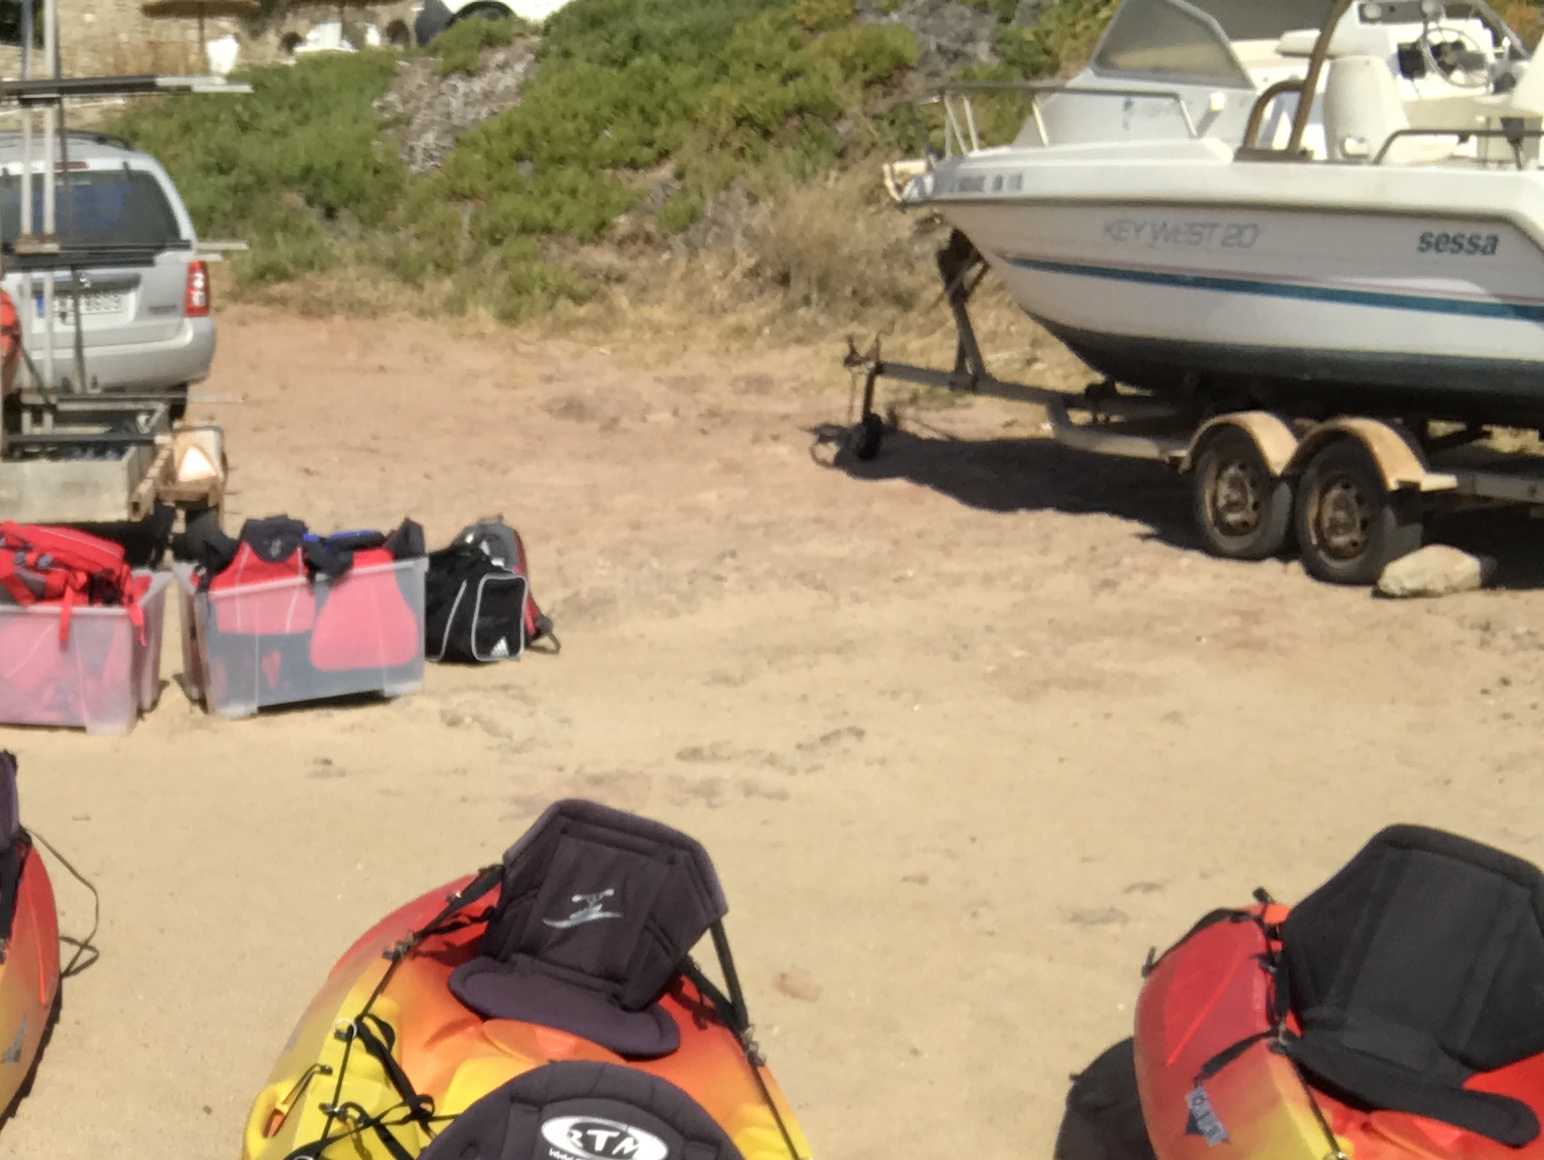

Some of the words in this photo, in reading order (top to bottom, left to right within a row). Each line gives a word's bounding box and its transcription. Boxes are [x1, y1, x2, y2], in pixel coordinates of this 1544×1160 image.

[1104, 218, 1148, 242] KEY
[1148, 220, 1221, 247] WEST
[1222, 222, 1260, 249] 20
[1417, 231, 1499, 255] sessa
[568, 1128, 642, 1160] RTM
